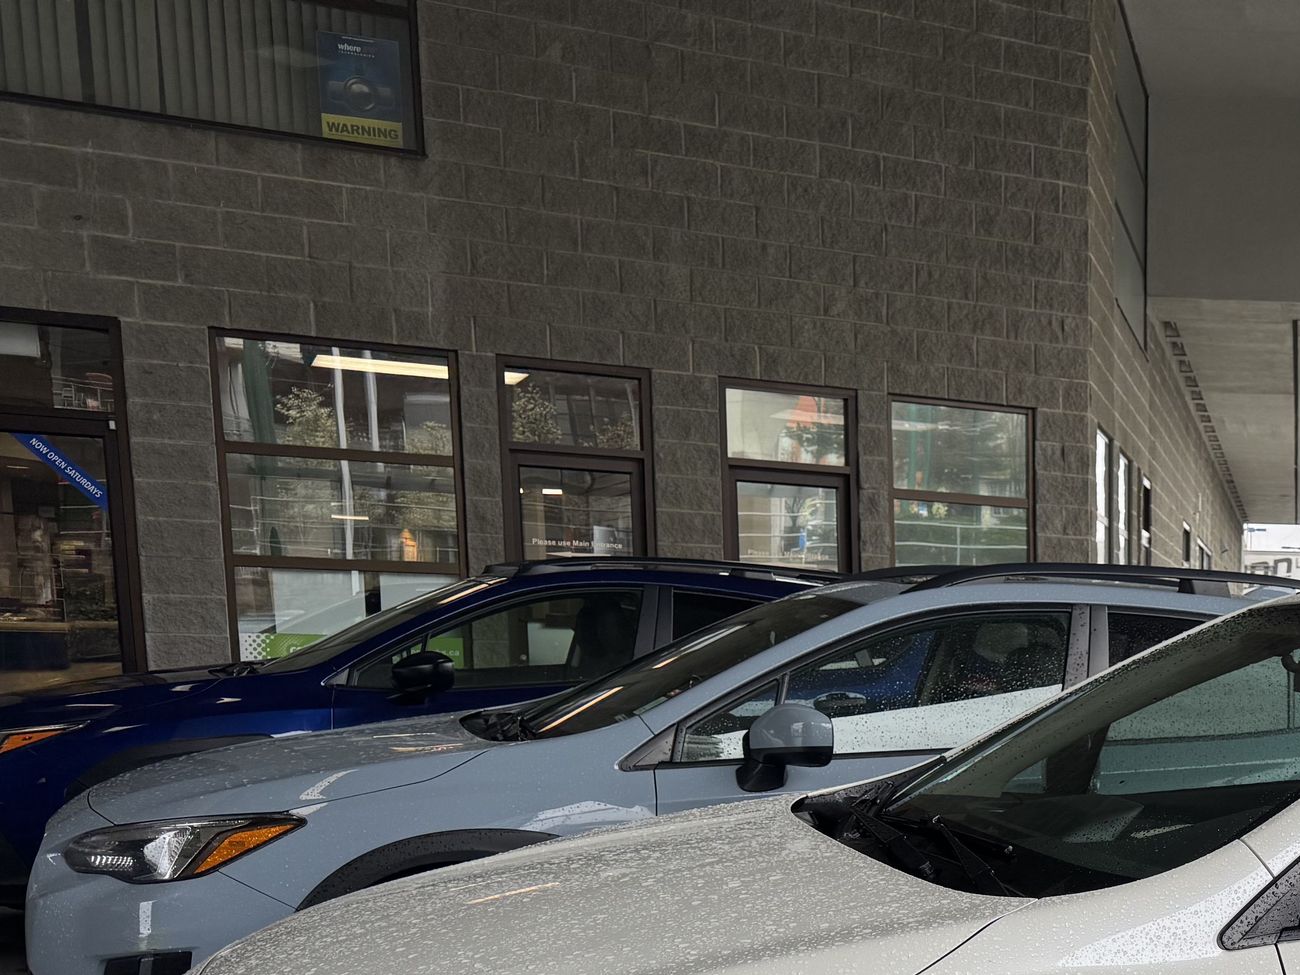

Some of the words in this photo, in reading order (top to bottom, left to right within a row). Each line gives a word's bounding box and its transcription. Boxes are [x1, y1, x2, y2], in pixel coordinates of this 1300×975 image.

[326, 121, 399, 140] WARNING
[29, 437, 49, 455] NOW
[47, 452, 67, 470] OPEN
[64, 466, 103, 498] SATURDAYS
[532, 538, 556, 546] Please
[572, 540, 590, 548] Main
